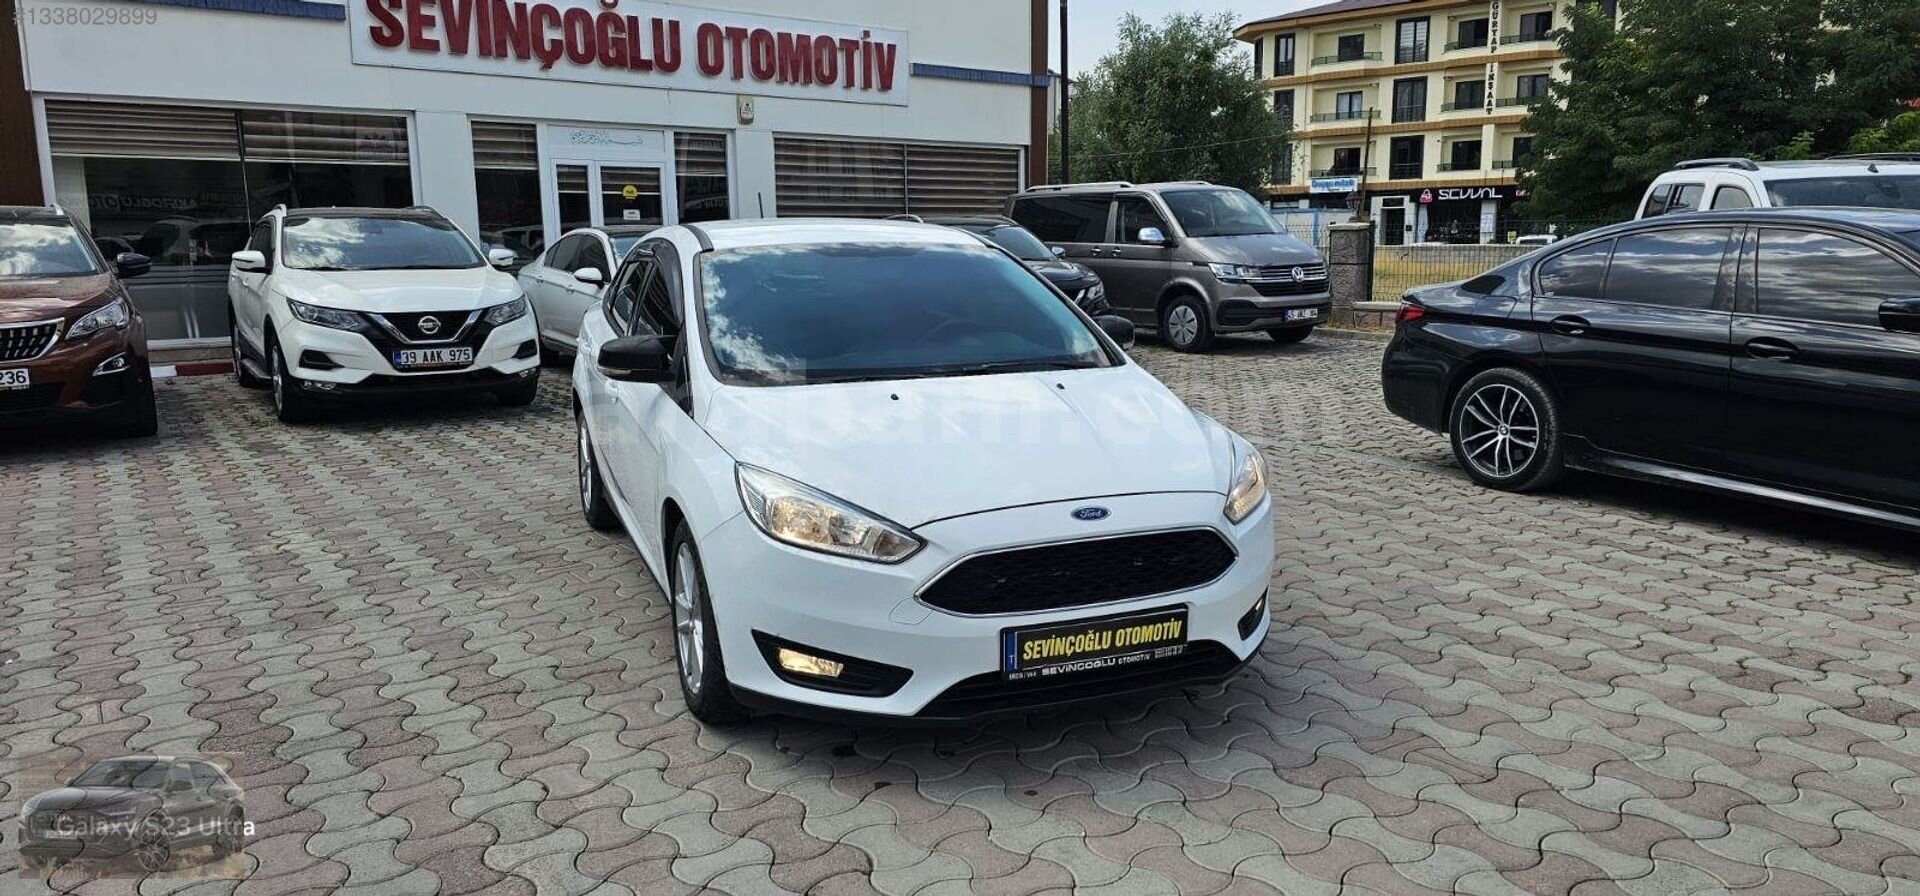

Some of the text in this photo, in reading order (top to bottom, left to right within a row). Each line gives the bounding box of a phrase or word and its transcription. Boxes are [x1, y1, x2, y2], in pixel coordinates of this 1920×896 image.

[696, 29, 897, 92] OTOMOTİV
[402, 348, 470, 364] 39 AAK 975
[1023, 617, 1182, 660] SEVİNÇOĞLU OTOMOTİV
